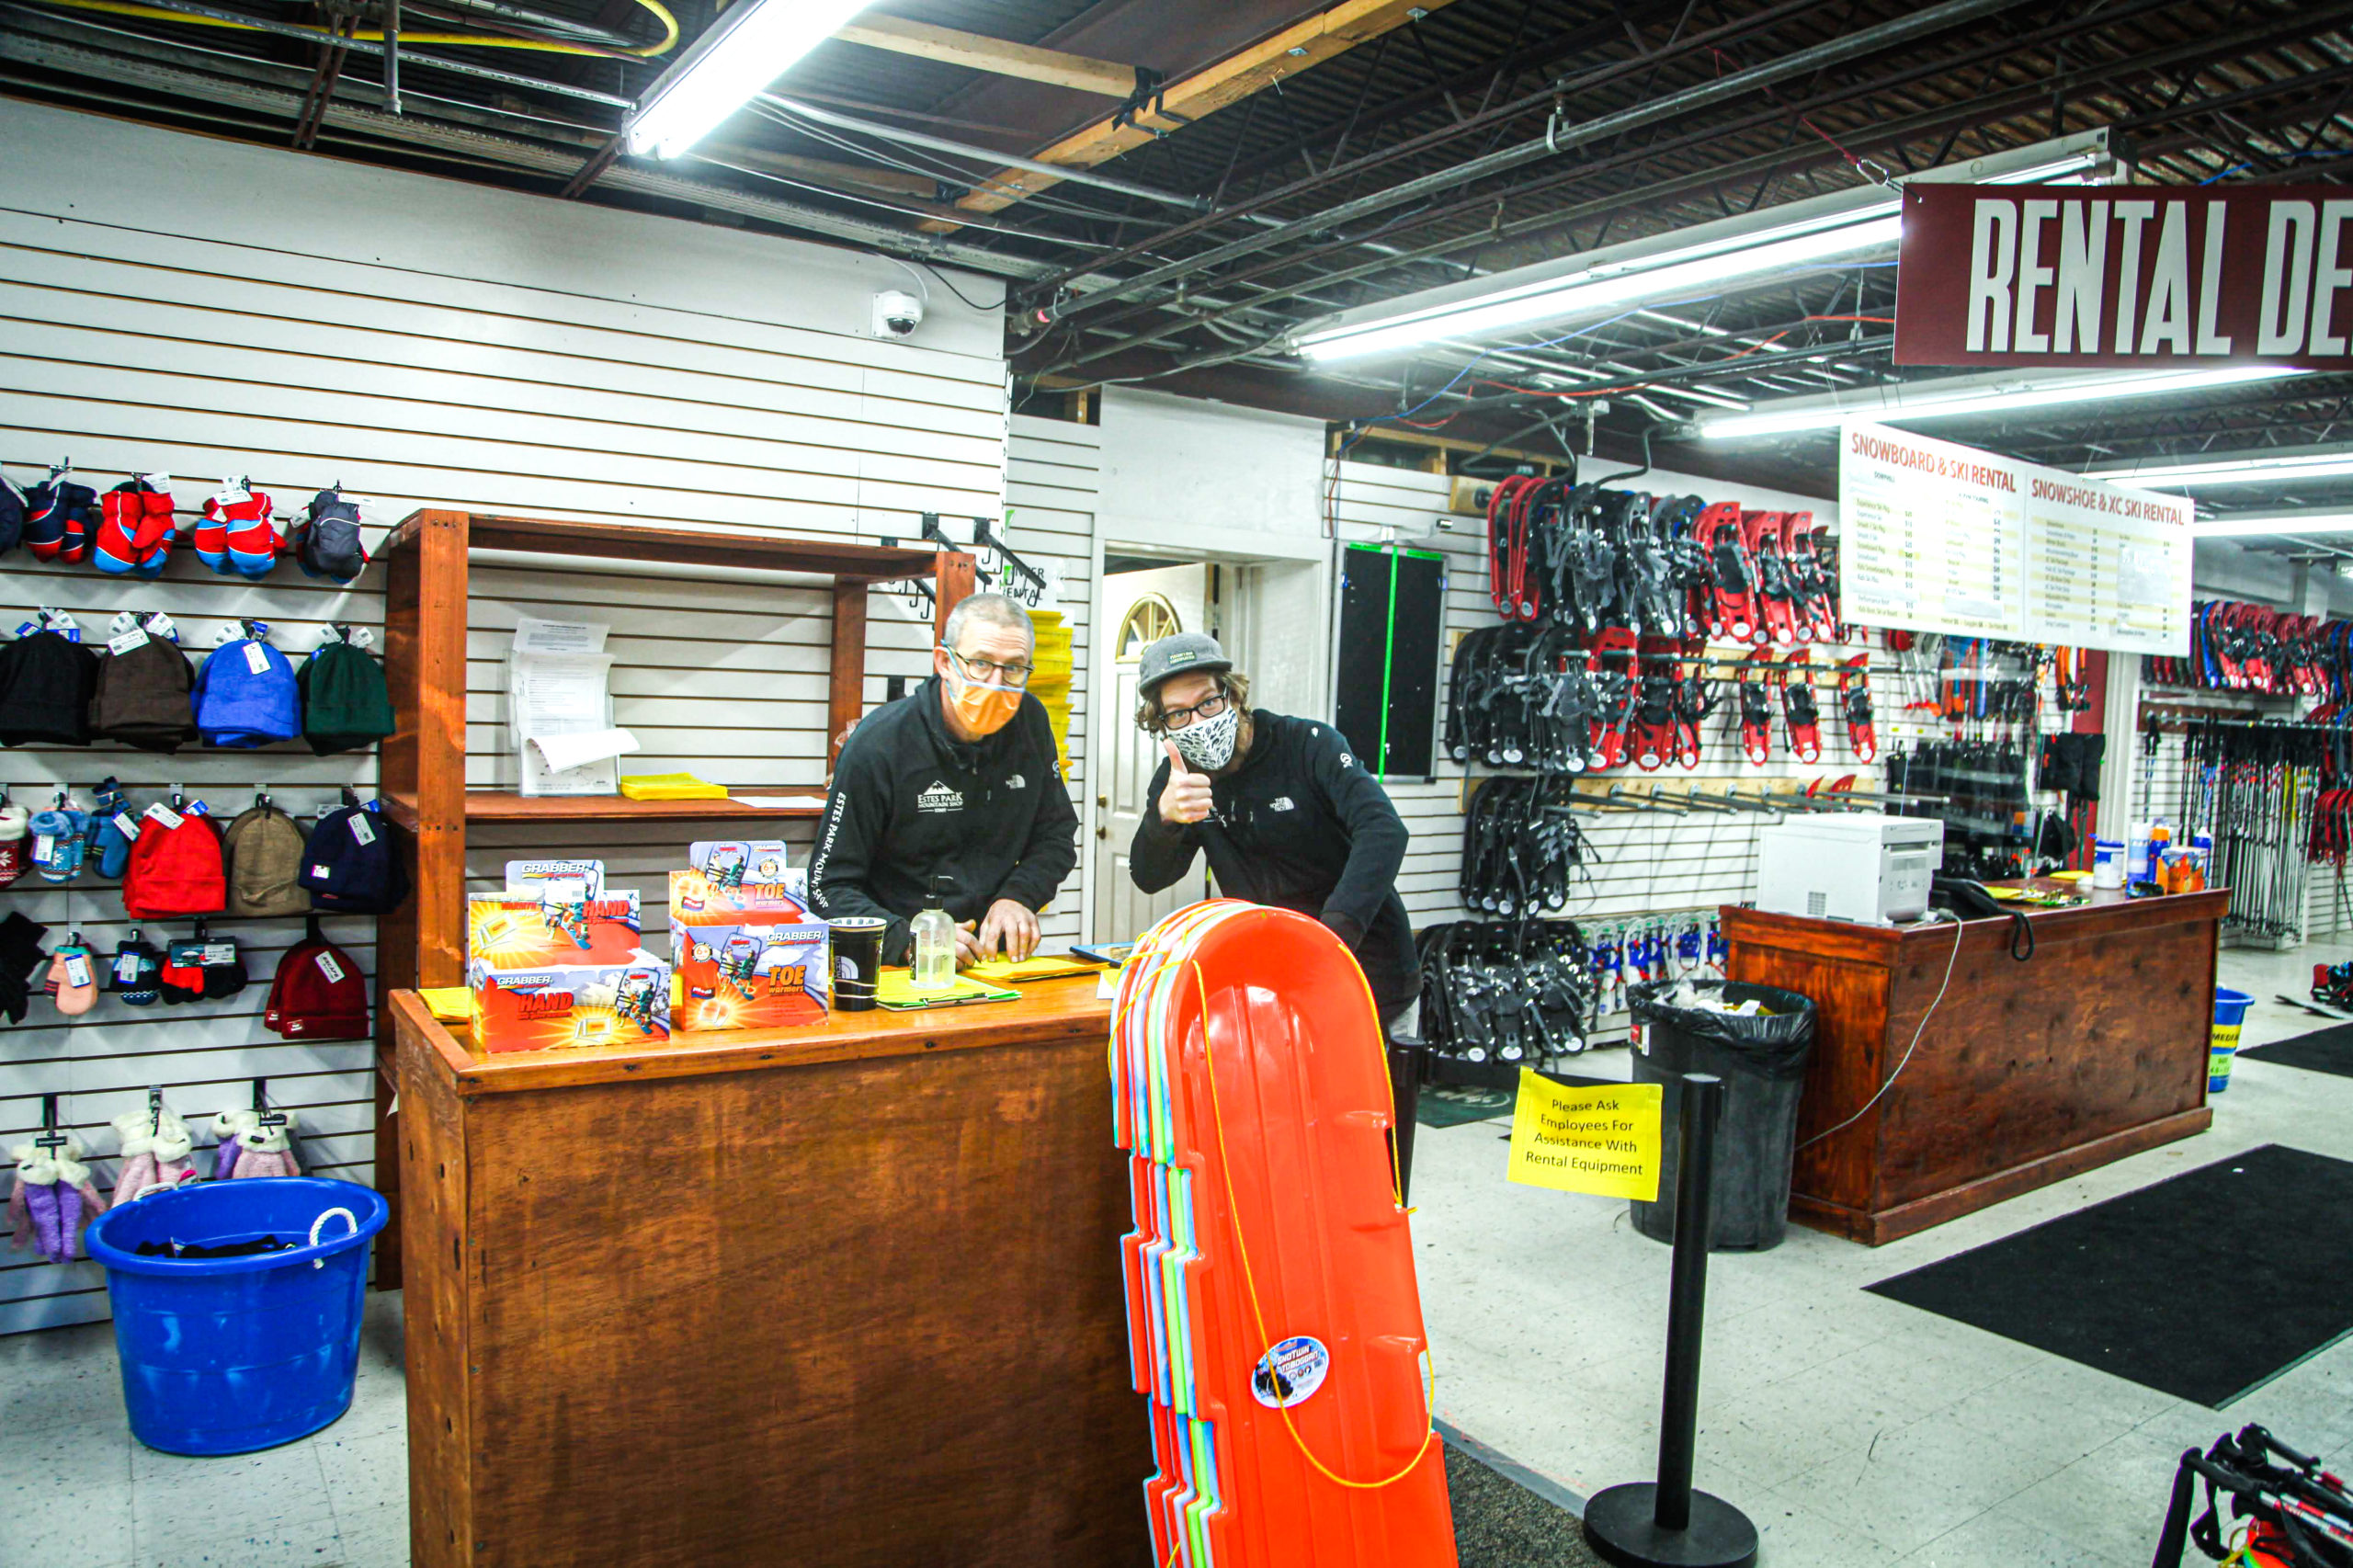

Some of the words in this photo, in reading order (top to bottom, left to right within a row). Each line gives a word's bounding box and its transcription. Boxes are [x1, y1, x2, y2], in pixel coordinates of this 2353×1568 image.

[1966, 199, 2232, 355] RENTAL
[2256, 199, 2353, 357] DE
[1851, 432, 1935, 473] SNOWBOARD
[1938, 457, 1947, 476] &
[1950, 460, 1969, 482] SKI
[1972, 465, 2017, 493] RENTAL
[2031, 478, 2096, 510] SNOWSHOE
[2098, 494, 2107, 512] &
[2109, 494, 2122, 515] XC
[2124, 498, 2141, 518] SKI
[2143, 502, 2184, 526] RENTAL
[917, 794, 939, 803] ESTES
[940, 791, 963, 802] PARK
[831, 791, 847, 823] ESTES
[824, 823, 838, 853] PARK
[521, 863, 586, 874] GRABBER
[755, 883, 786, 900] TOE
[582, 900, 631, 917] HAND
[766, 930, 823, 942] GRABBER
[496, 975, 551, 986] GRABBER
[768, 965, 807, 986] TOE
[768, 985, 804, 994] warmers
[519, 992, 574, 1012] HAND
[1552, 1098, 1592, 1112] Please
[1596, 1099, 1620, 1111] Ask
[1540, 1113, 1608, 1132] Employees
[1612, 1119, 1634, 1131] For
[1534, 1131, 1602, 1150] Assistance
[1606, 1139, 1637, 1153] With
[1526, 1151, 1567, 1168] Rental
[1571, 1156, 1643, 1176] Equipment
